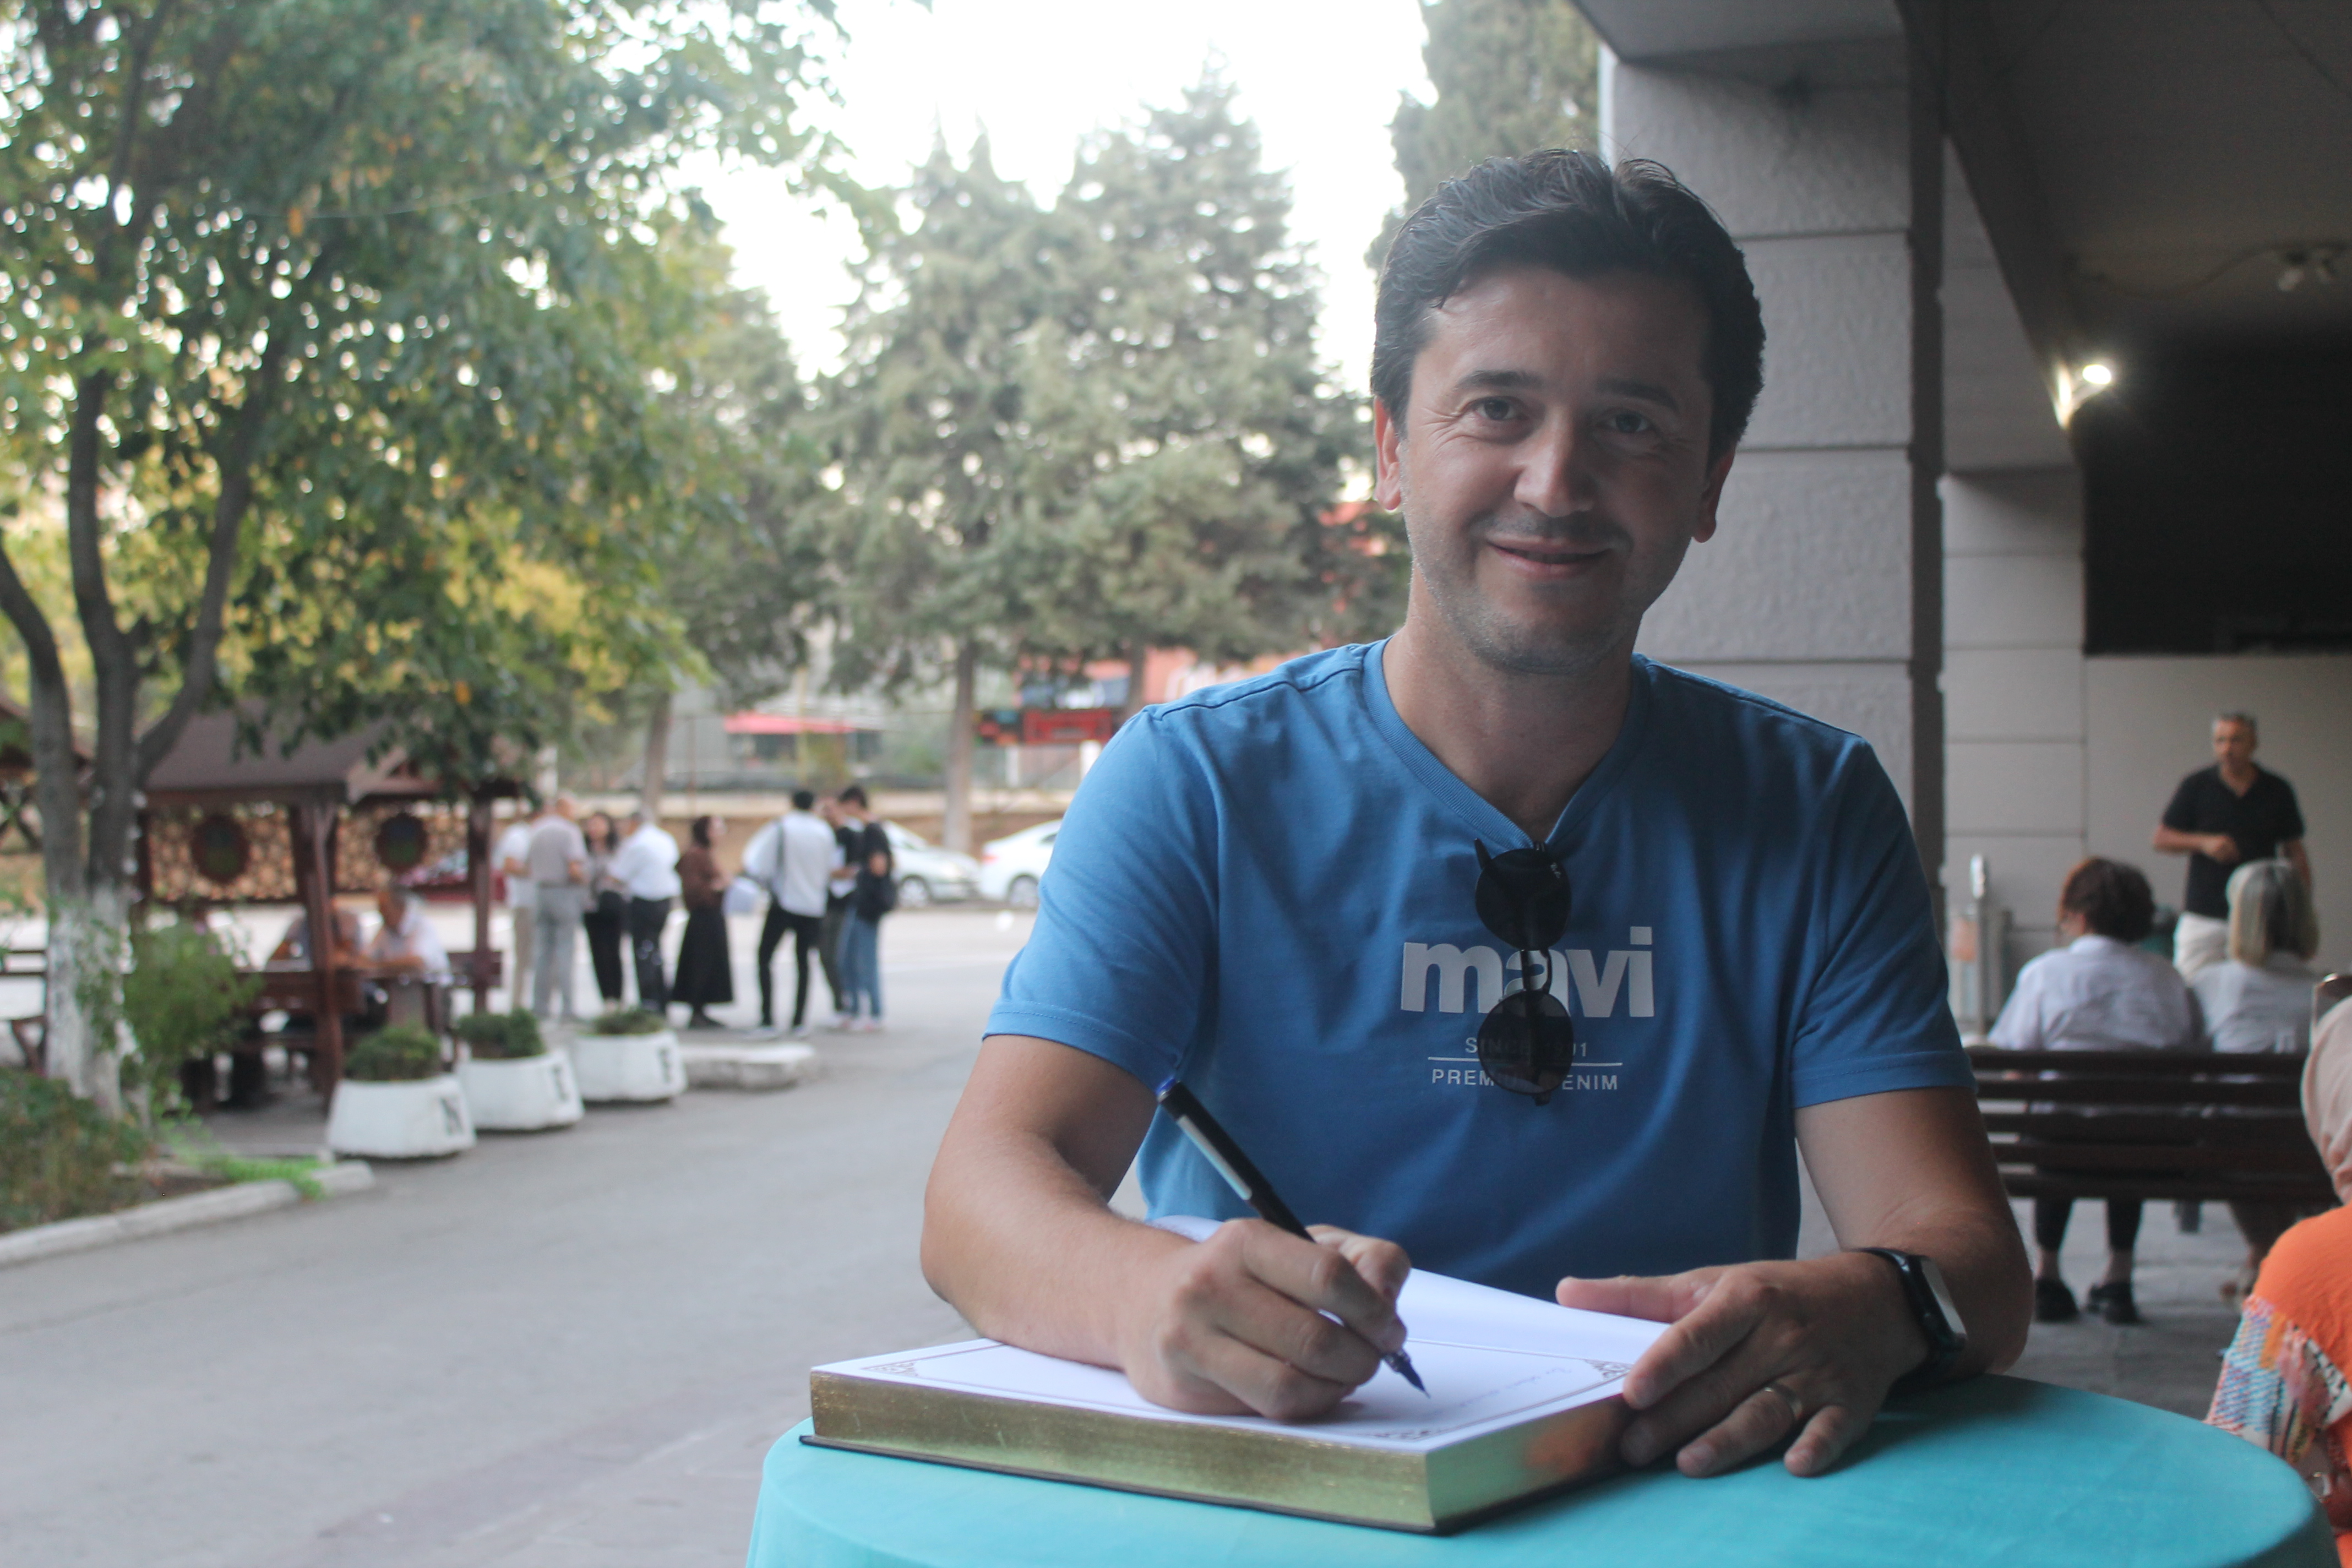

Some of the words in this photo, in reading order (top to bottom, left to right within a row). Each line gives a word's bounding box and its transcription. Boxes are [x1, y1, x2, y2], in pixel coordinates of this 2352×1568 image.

[1400, 926, 1654, 1017] mavi
[1431, 1069, 1495, 1086] PREM
[1561, 1075, 1618, 1091] ENIM
